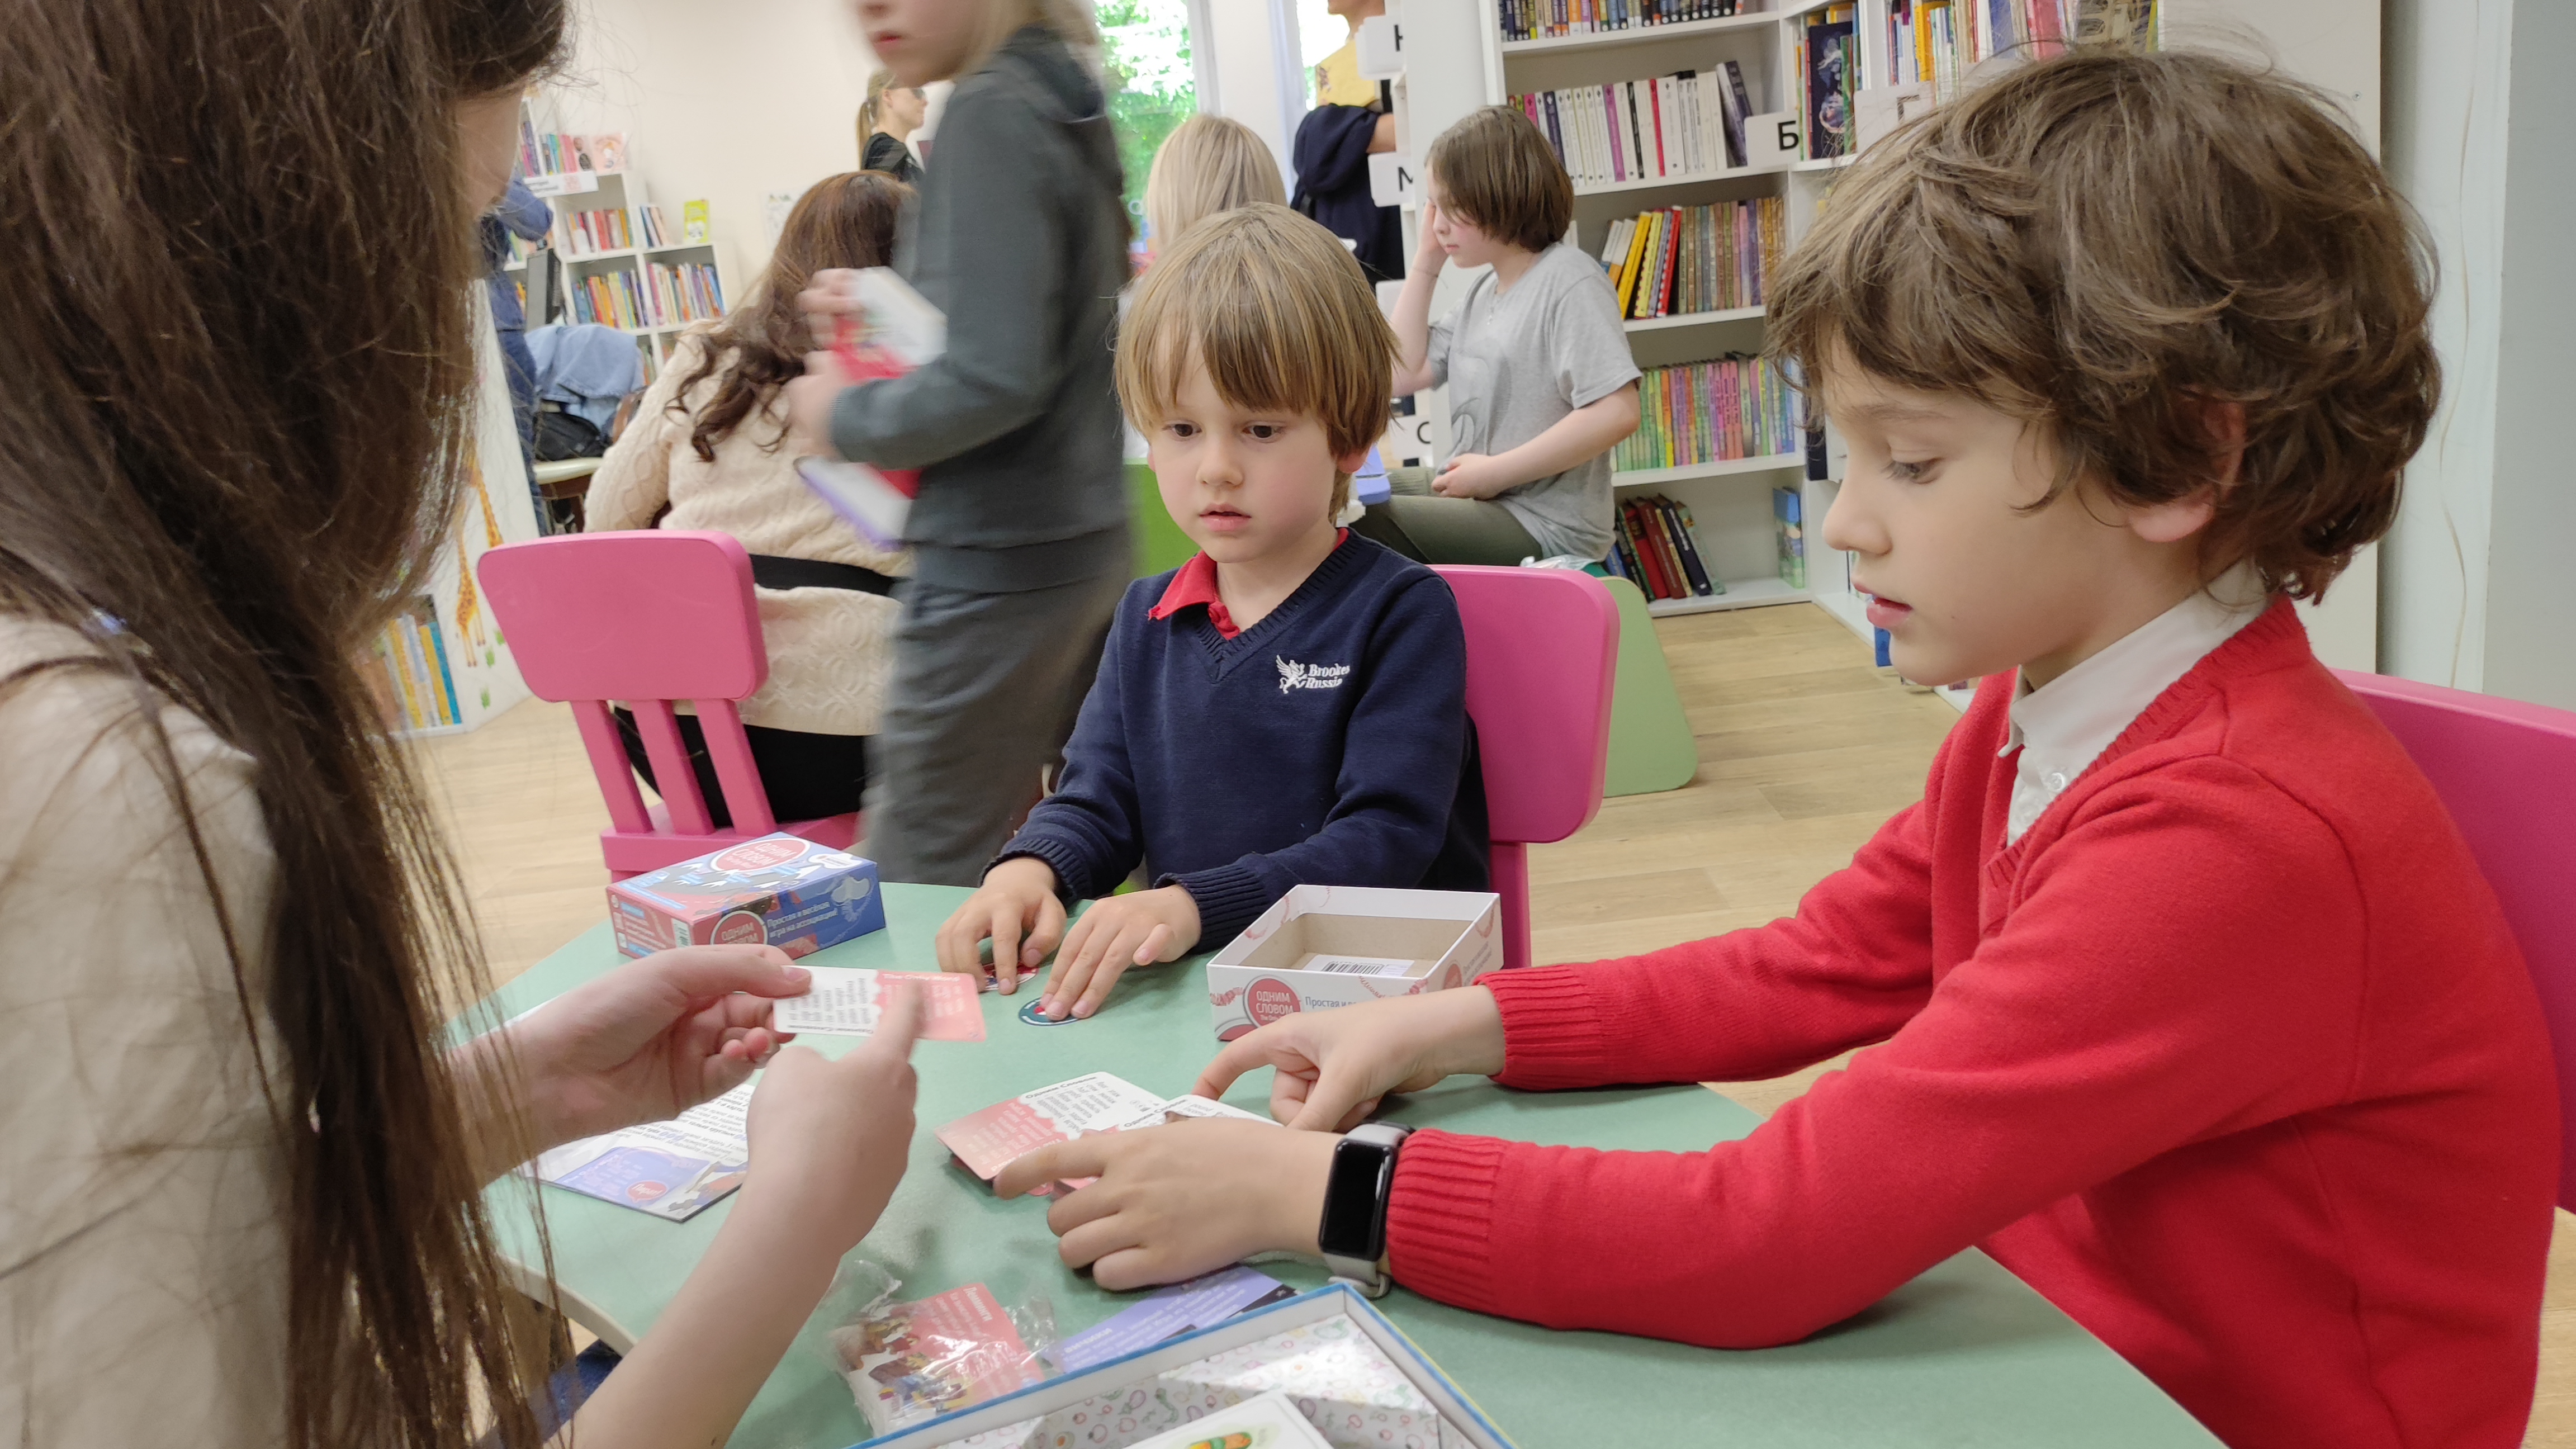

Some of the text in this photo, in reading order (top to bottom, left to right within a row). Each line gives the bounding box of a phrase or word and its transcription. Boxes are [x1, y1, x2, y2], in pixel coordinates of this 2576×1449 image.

[1778, 120, 1799, 151] Б
[1308, 663, 1351, 677] Brookes
[1305, 676, 1343, 689] Russia
[732, 849, 778, 865] СЛОВОМ
[754, 842, 797, 858] ОДНИМ
[766, 912, 796, 929] Простая
[721, 922, 755, 941] ОДНИМ
[769, 928, 786, 939] игра
[1256, 991, 1291, 1003] ОДНИМ
[1305, 997, 1340, 1009] Простая
[1256, 1003, 1294, 1015] СЛОВОМ
[1025, 1076, 1097, 1100] Одним Словом
[962, 1286, 993, 1322] Лемминги
